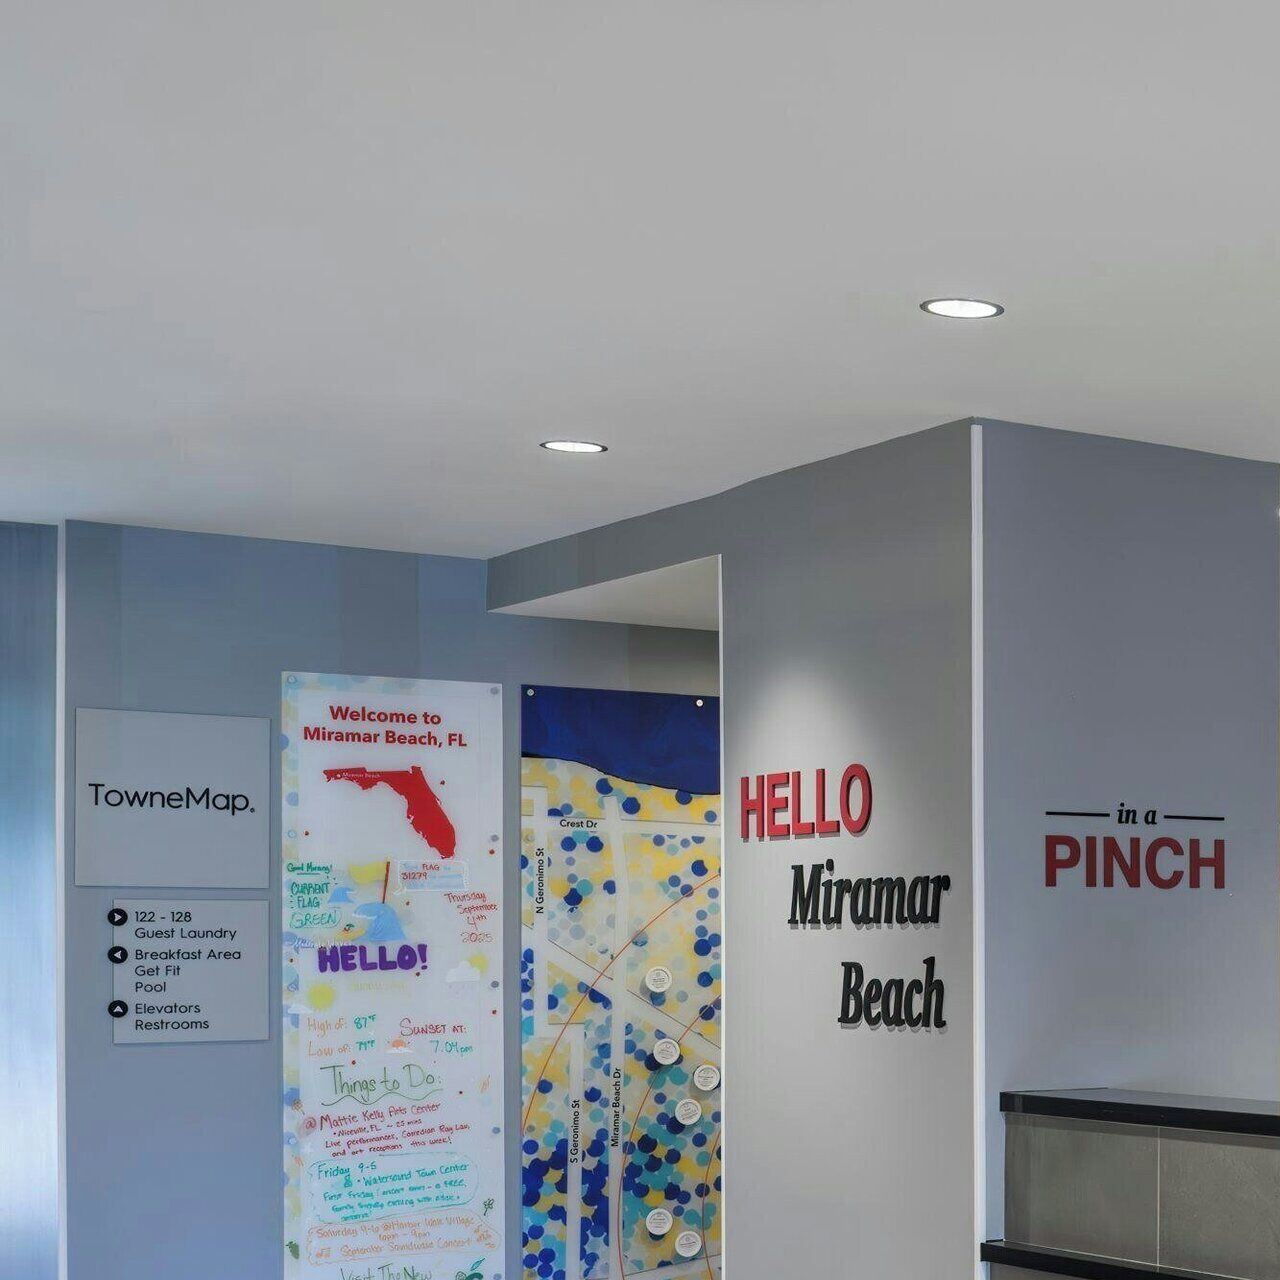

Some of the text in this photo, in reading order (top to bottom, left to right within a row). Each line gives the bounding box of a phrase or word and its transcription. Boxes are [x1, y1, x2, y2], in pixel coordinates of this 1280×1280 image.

[329, 705, 442, 725] Welcome to
[303, 726, 467, 748] Miramar Beach, FL
[88, 783, 250, 816] TowneMap
[740, 763, 873, 839] HELLO
[1117, 802, 1157, 825] in a
[560, 819, 597, 828] Crest Dr
[287, 863, 304, 872] Good
[1045, 835, 1225, 890] PINCH
[291, 882, 330, 895] CURRENT
[536, 848, 544, 914] N Geronimo St
[444, 891, 487, 903] Thursday
[788, 858, 950, 925] Miramar
[297, 896, 320, 909] FLAG
[134, 911, 155, 923] 122
[171, 911, 192, 923] 128
[292, 910, 336, 927] GREEN
[467, 914, 487, 930] 4th
[134, 927, 237, 941] Guest Laundry
[461, 932, 493, 943] 2025
[135, 949, 241, 960] Breakfast Area
[318, 944, 428, 973] HELLO!
[134, 965, 181, 976] Get Fit
[135, 982, 166, 993] Pool
[838, 956, 947, 1029] Beach
[135, 1003, 201, 1014] Elevators
[135, 1019, 209, 1031] Restrooms
[307, 1016, 331, 1038] High
[307, 1041, 333, 1057] Low
[320, 1065, 377, 1103] Things
[380, 1067, 400, 1091] to
[572, 1100, 580, 1108] St
[611, 1068, 621, 1147] Miramar Beach Dr
[320, 1114, 358, 1131] Mattie
[362, 1109, 385, 1123] Kelly
[389, 1105, 407, 1117] Arts
[411, 1102, 441, 1115] Center
[371, 1124, 381, 1132] FL
[570, 1113, 580, 1156] Geronimo
[332, 1150, 347, 1158] and
[317, 1163, 350, 1180] Friday
[416, 1168, 437, 1178] Town
[439, 1162, 470, 1176] Center
[316, 1227, 358, 1240] Saturday
